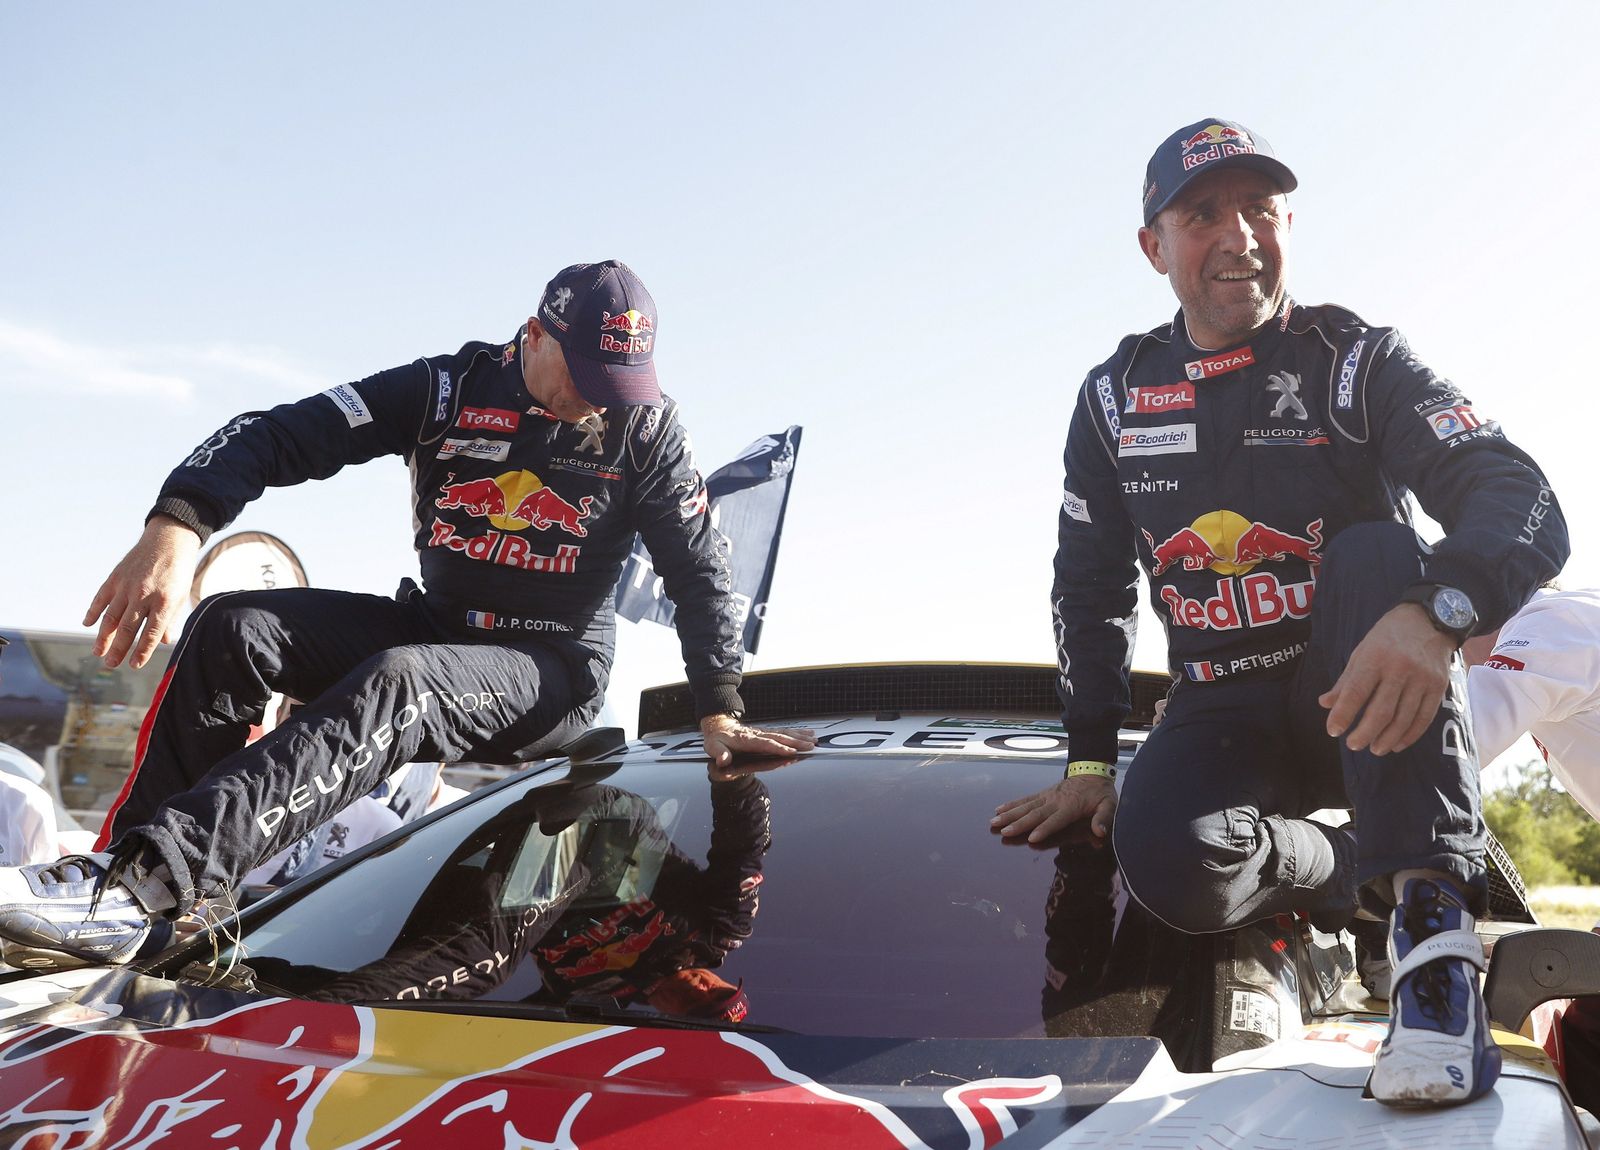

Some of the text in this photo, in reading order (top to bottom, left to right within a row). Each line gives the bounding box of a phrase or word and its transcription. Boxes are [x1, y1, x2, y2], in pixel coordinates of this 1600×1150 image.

[1182, 144, 1220, 171] Red
[600, 334, 631, 354] Red
[1204, 355, 1251, 373] TOTAL
[1096, 375, 1122, 439] sparco
[1141, 390, 1193, 407] TOTAL
[464, 412, 515, 428] TOTAL
[1120, 432, 1188, 446] BFGoodrich
[551, 457, 623, 474] PEUGEOT SPORT
[1122, 480, 1178, 494] ZENITH
[428, 517, 582, 573] Red Bull
[1160, 577, 1243, 631] Red
[496, 618, 574, 632] J. P. COTTRE
[1214, 664, 1228, 677] S.
[256, 692, 434, 838] PEUGEOT
